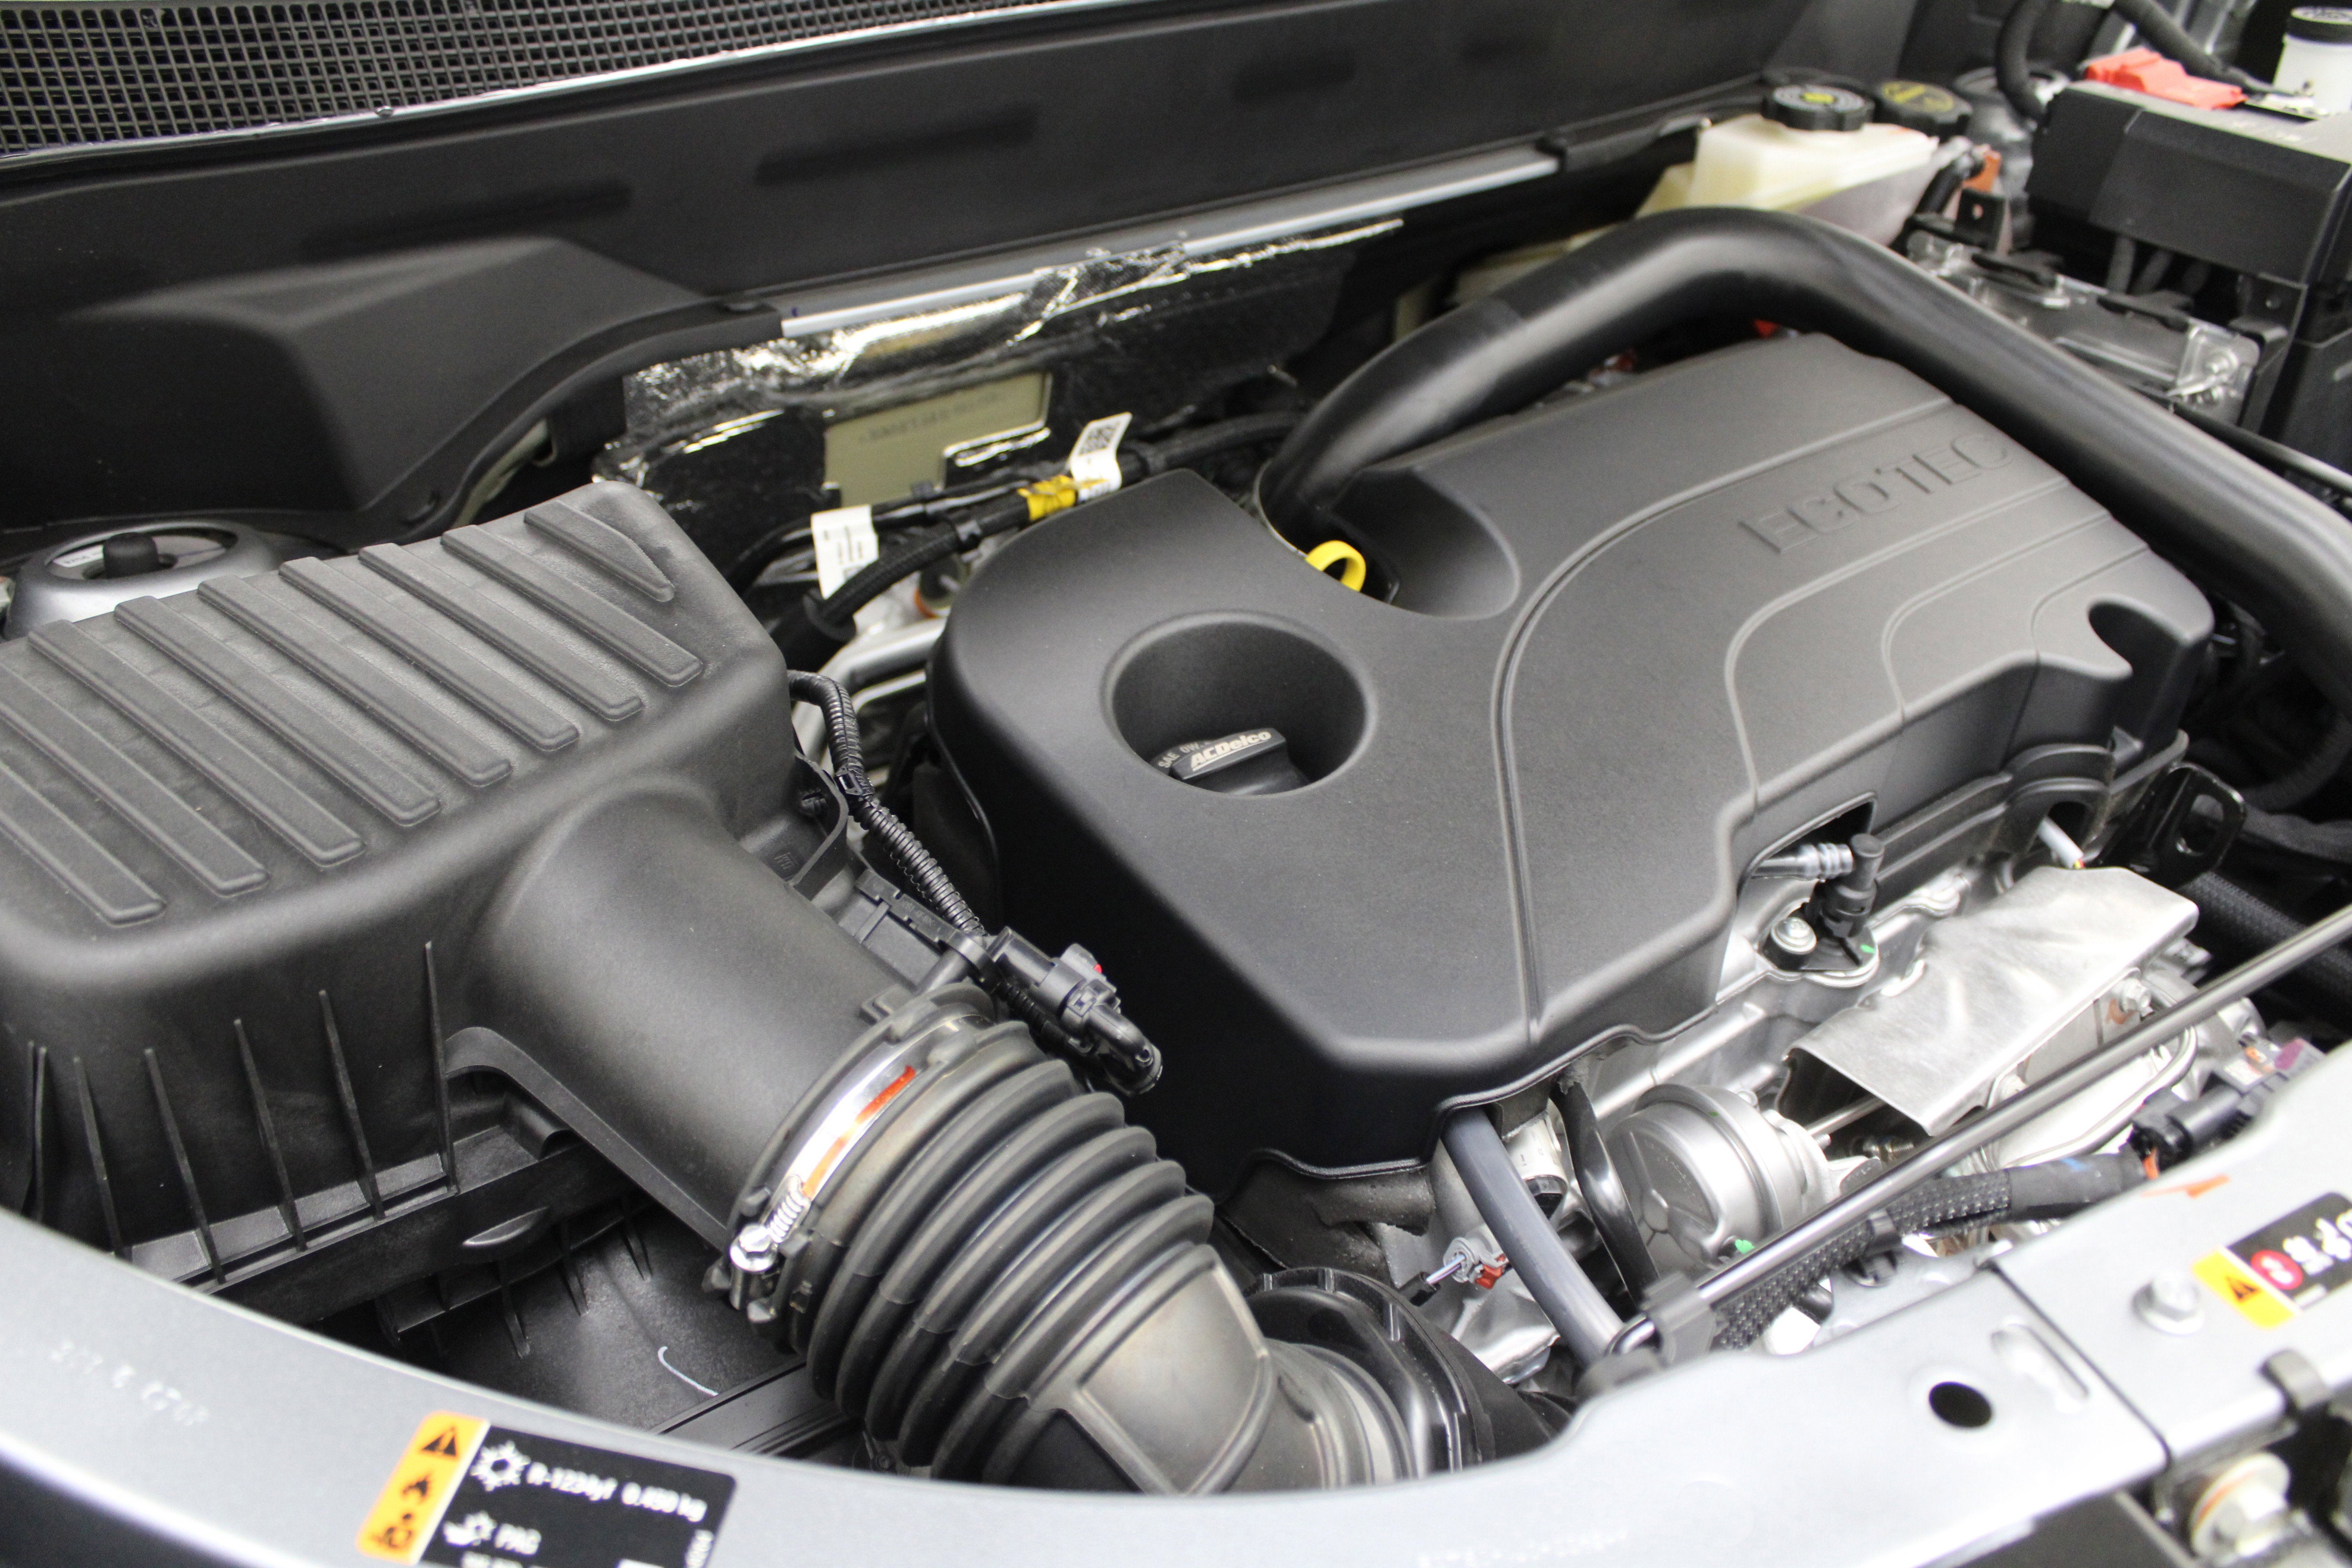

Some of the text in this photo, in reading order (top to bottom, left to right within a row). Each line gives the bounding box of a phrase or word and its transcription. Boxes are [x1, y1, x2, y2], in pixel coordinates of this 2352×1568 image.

[1737, 432, 2013, 554] ECOTEC
[1158, 752, 1180, 768] SAE
[1191, 731, 1272, 768] ACDelco
